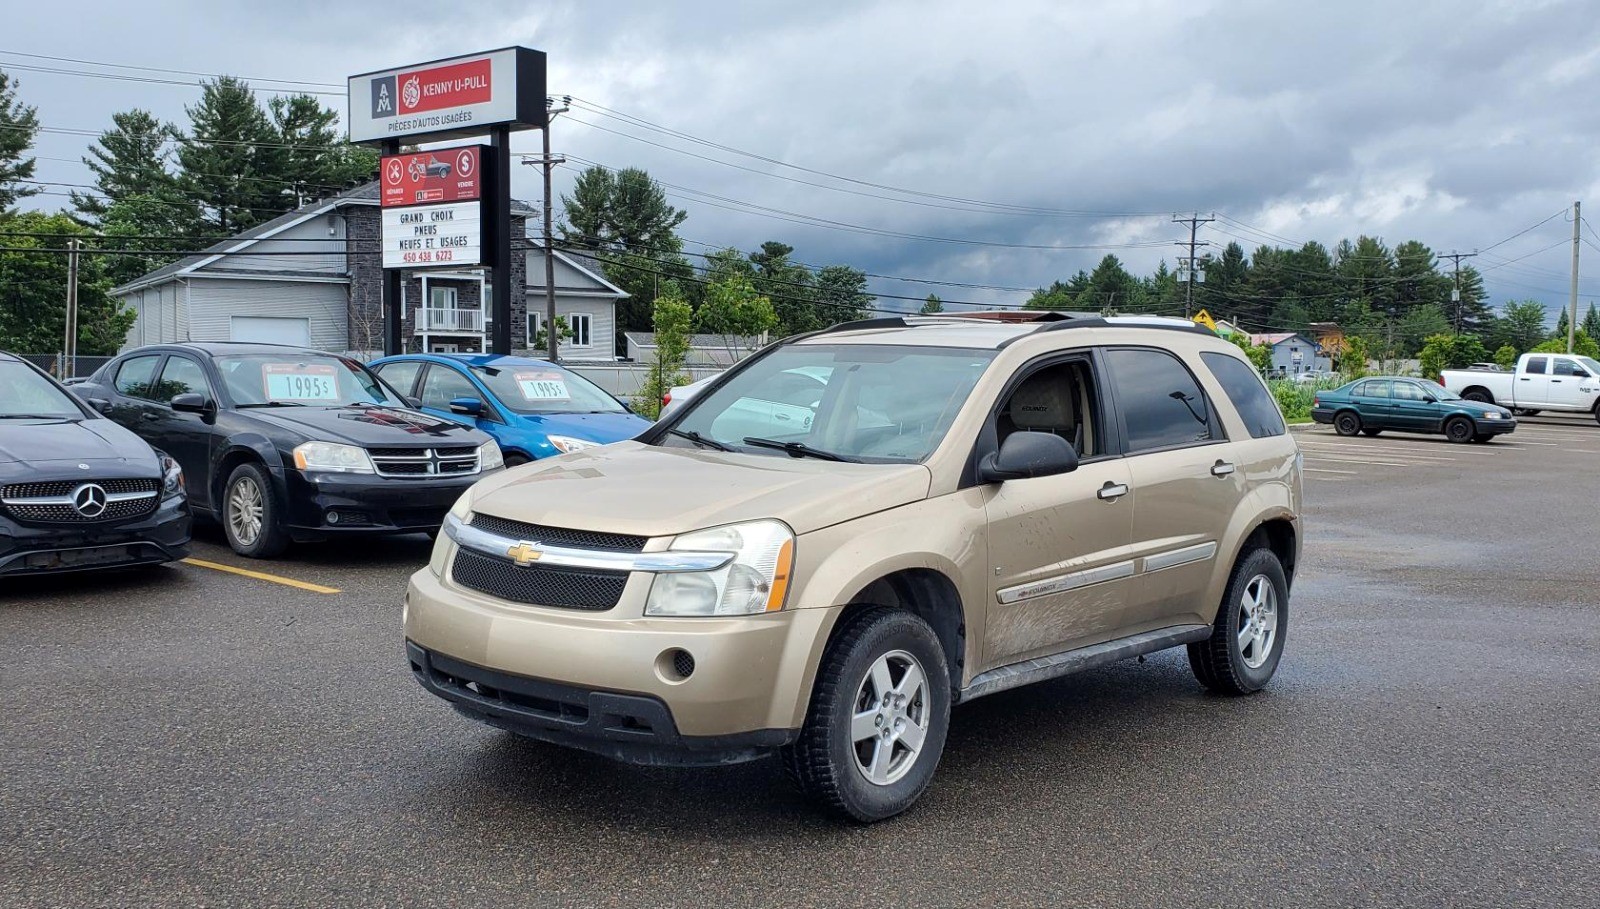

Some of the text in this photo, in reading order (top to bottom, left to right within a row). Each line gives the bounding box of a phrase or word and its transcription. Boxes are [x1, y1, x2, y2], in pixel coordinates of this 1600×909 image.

[423, 74, 488, 97] KENNY U-PULL
[388, 110, 472, 132] PIÈCES D'AUTOS USAGÉES
[400, 210, 454, 224] GRAND CHOIX
[414, 225, 437, 236] PNEUS
[399, 236, 468, 250] NEUFS ET USAGES
[403, 252, 416, 262] 450
[418, 251, 431, 262] 438
